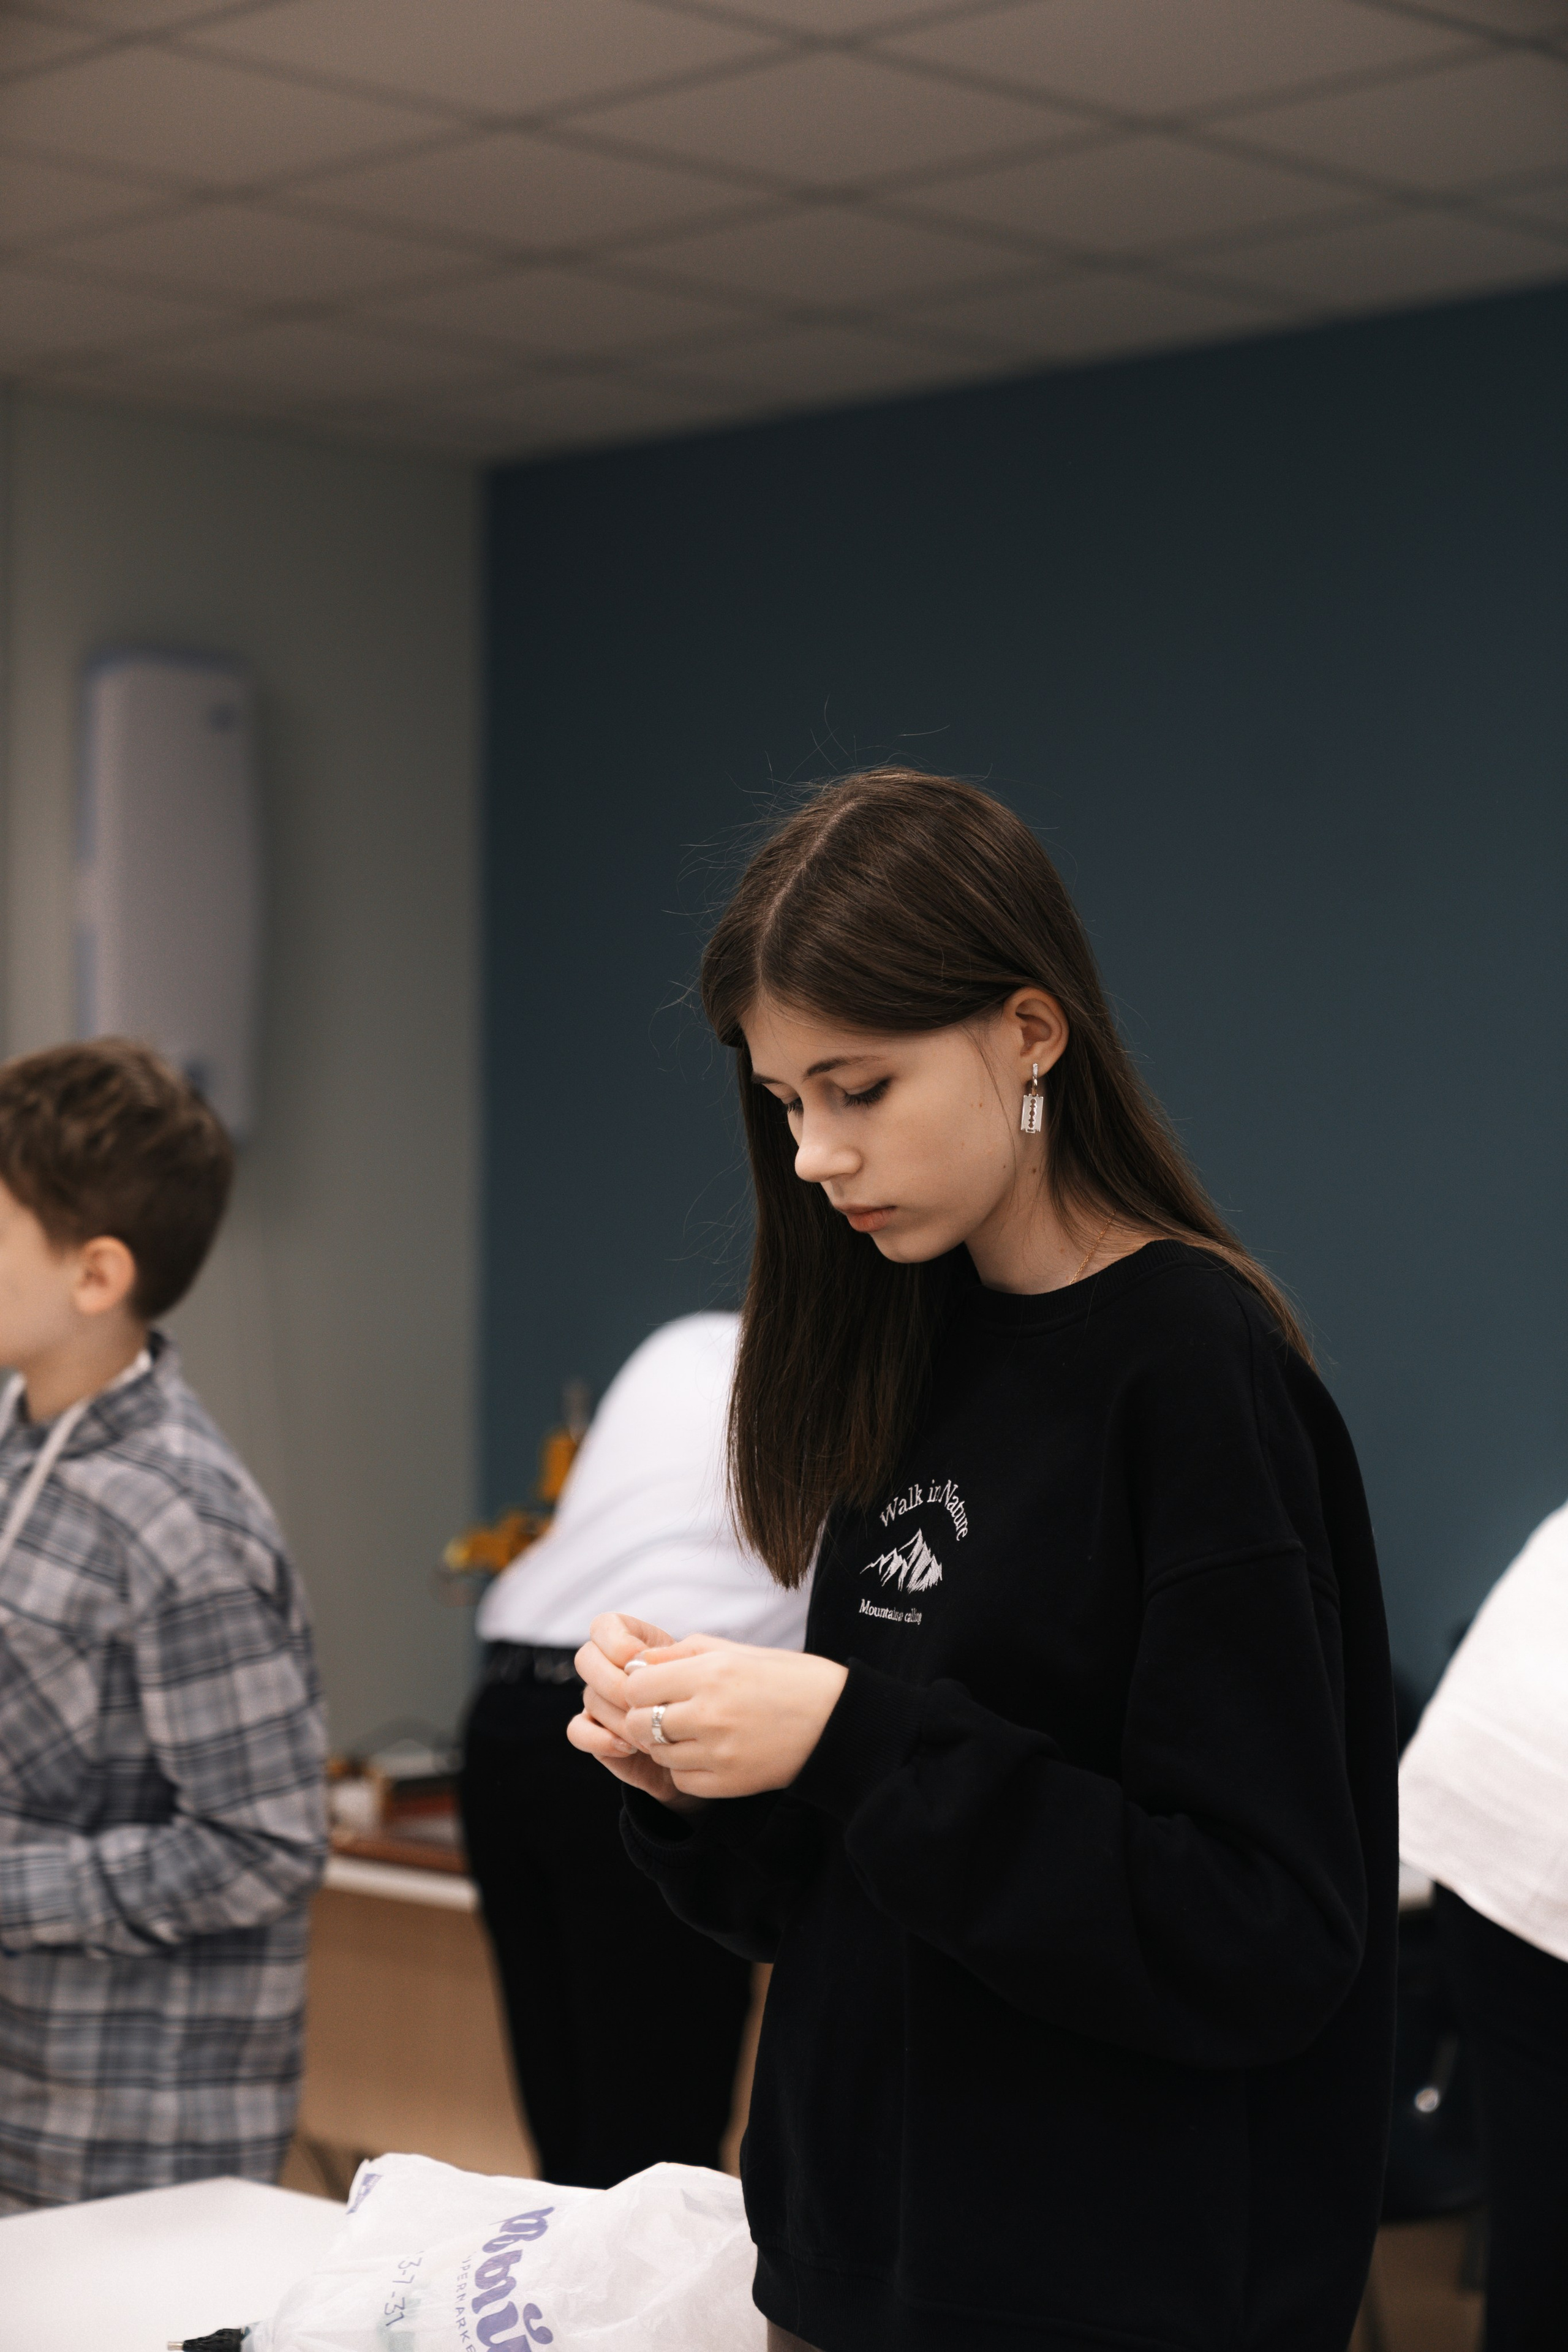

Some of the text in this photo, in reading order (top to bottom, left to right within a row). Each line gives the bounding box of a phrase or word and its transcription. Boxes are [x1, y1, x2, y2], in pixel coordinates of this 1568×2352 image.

[880, 1479, 968, 1541] Walk in Nature
